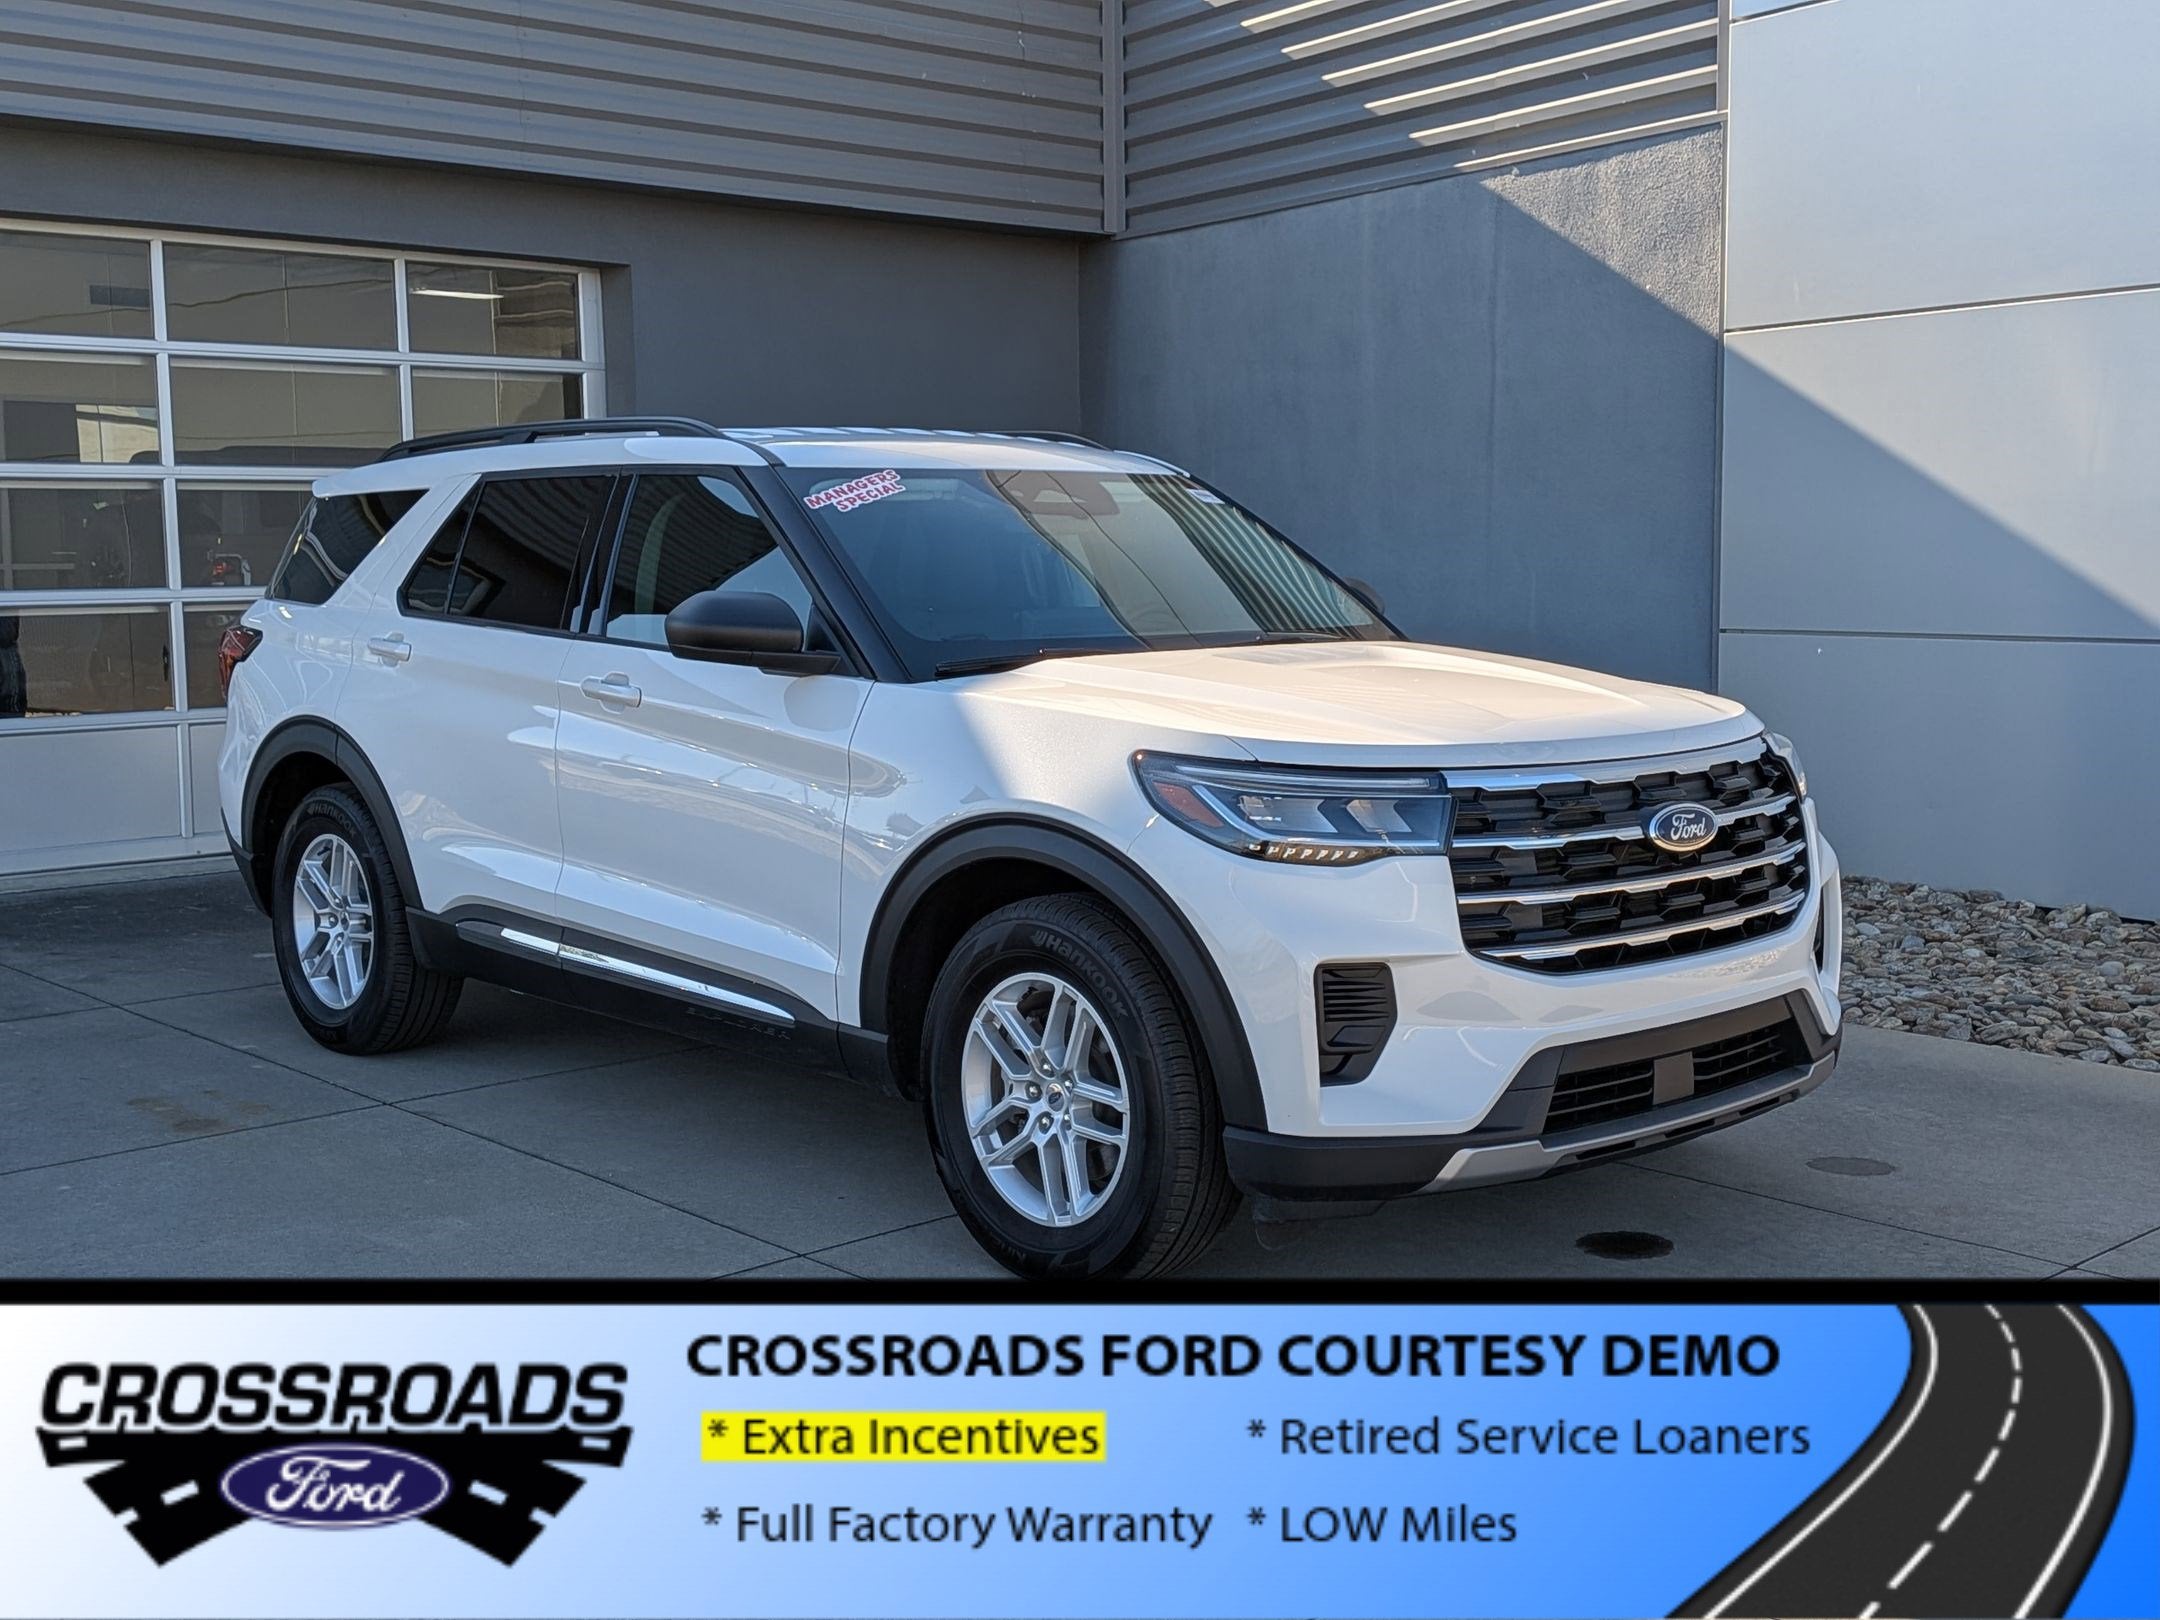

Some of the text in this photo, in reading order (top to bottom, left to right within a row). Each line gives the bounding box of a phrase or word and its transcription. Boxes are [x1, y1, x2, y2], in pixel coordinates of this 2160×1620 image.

[805, 470, 898, 508] MANAGERS
[836, 483, 903, 510] SPECIAL
[1670, 813, 1707, 840] Ford
[1045, 933, 1129, 1016] Hankook
